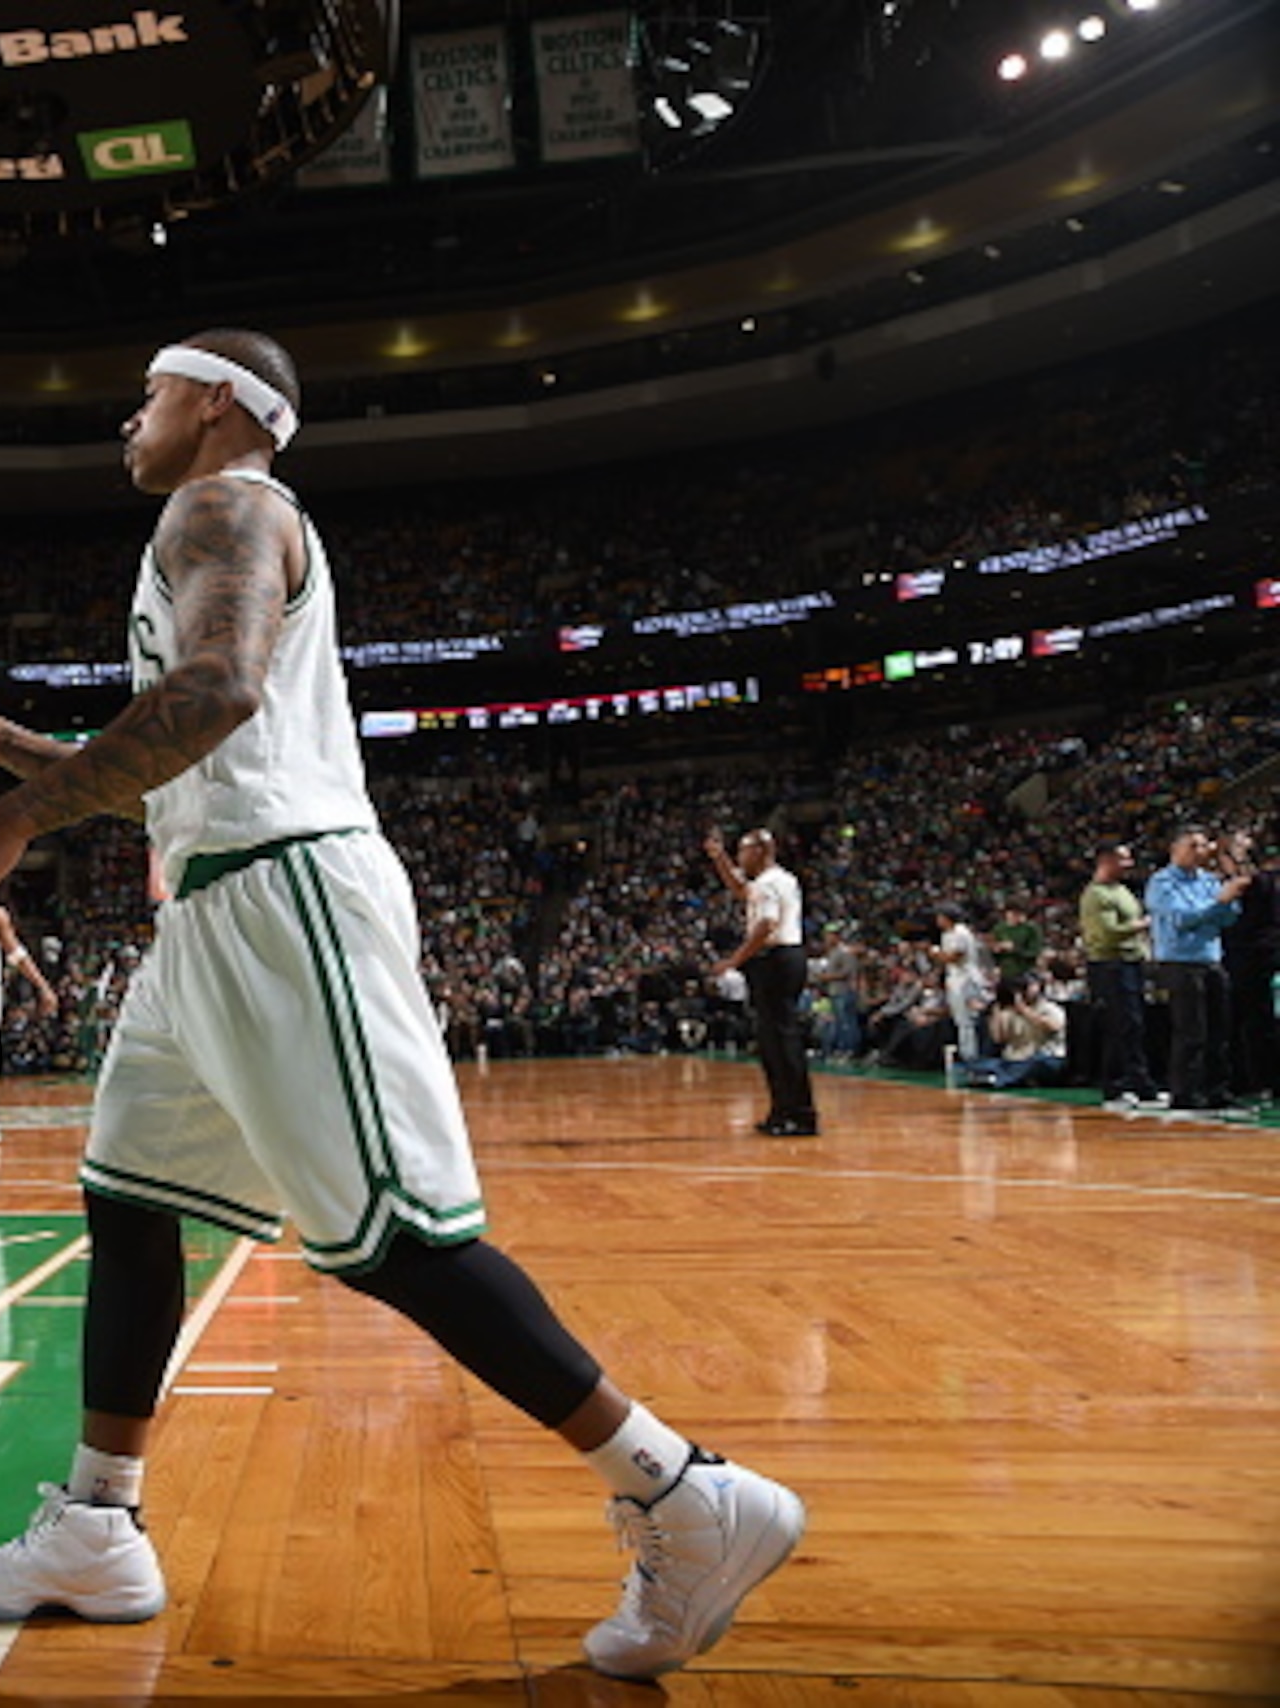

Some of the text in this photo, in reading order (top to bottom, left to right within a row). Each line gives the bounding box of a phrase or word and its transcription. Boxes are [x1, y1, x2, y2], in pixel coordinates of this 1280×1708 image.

[541, 27, 624, 52] BOSTON
[420, 43, 498, 69] BOSTON
[549, 49, 626, 74] CELTICS
[423, 65, 499, 92] CELTICS
[93, 133, 184, 170] TD
